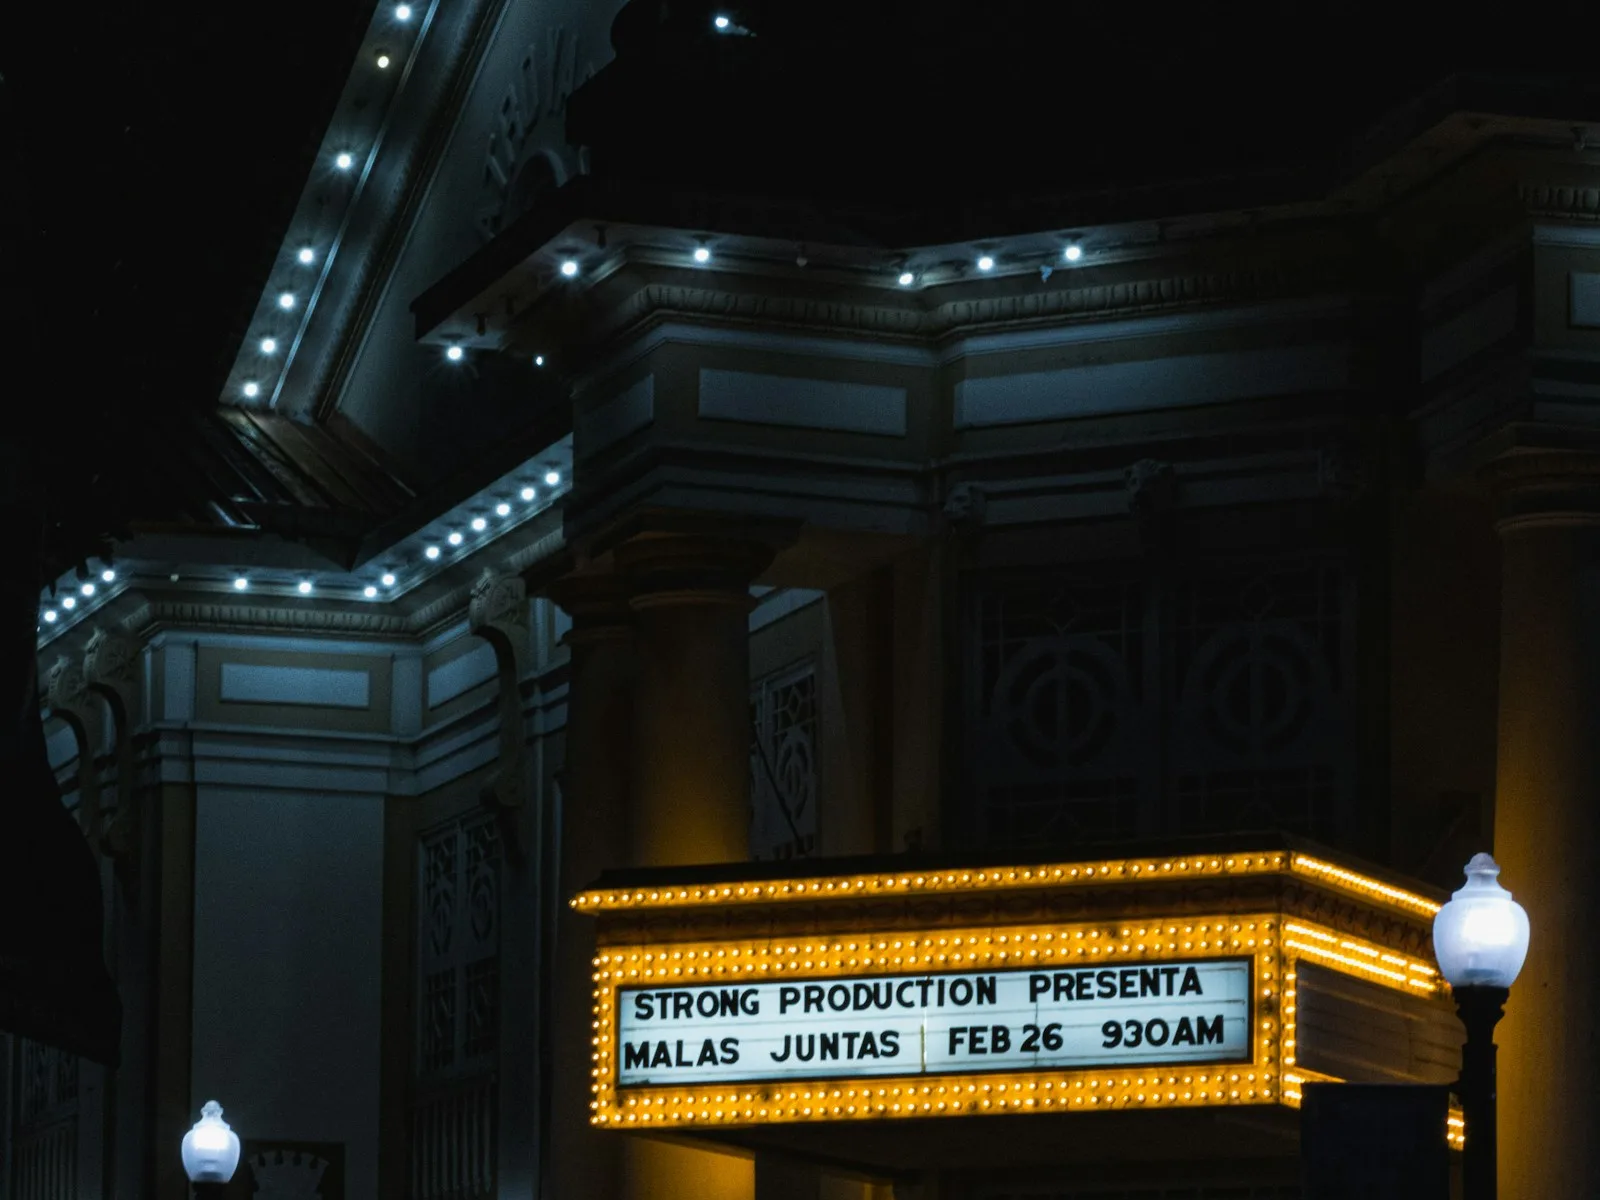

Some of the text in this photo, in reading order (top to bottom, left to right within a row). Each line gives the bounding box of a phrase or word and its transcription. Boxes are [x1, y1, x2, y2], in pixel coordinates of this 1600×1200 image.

[634, 966, 1203, 1021] STRONG PRODUCTION PRESENTA
[624, 1014, 1225, 1071] MALAS JUNTAS FEB 26 930AM
